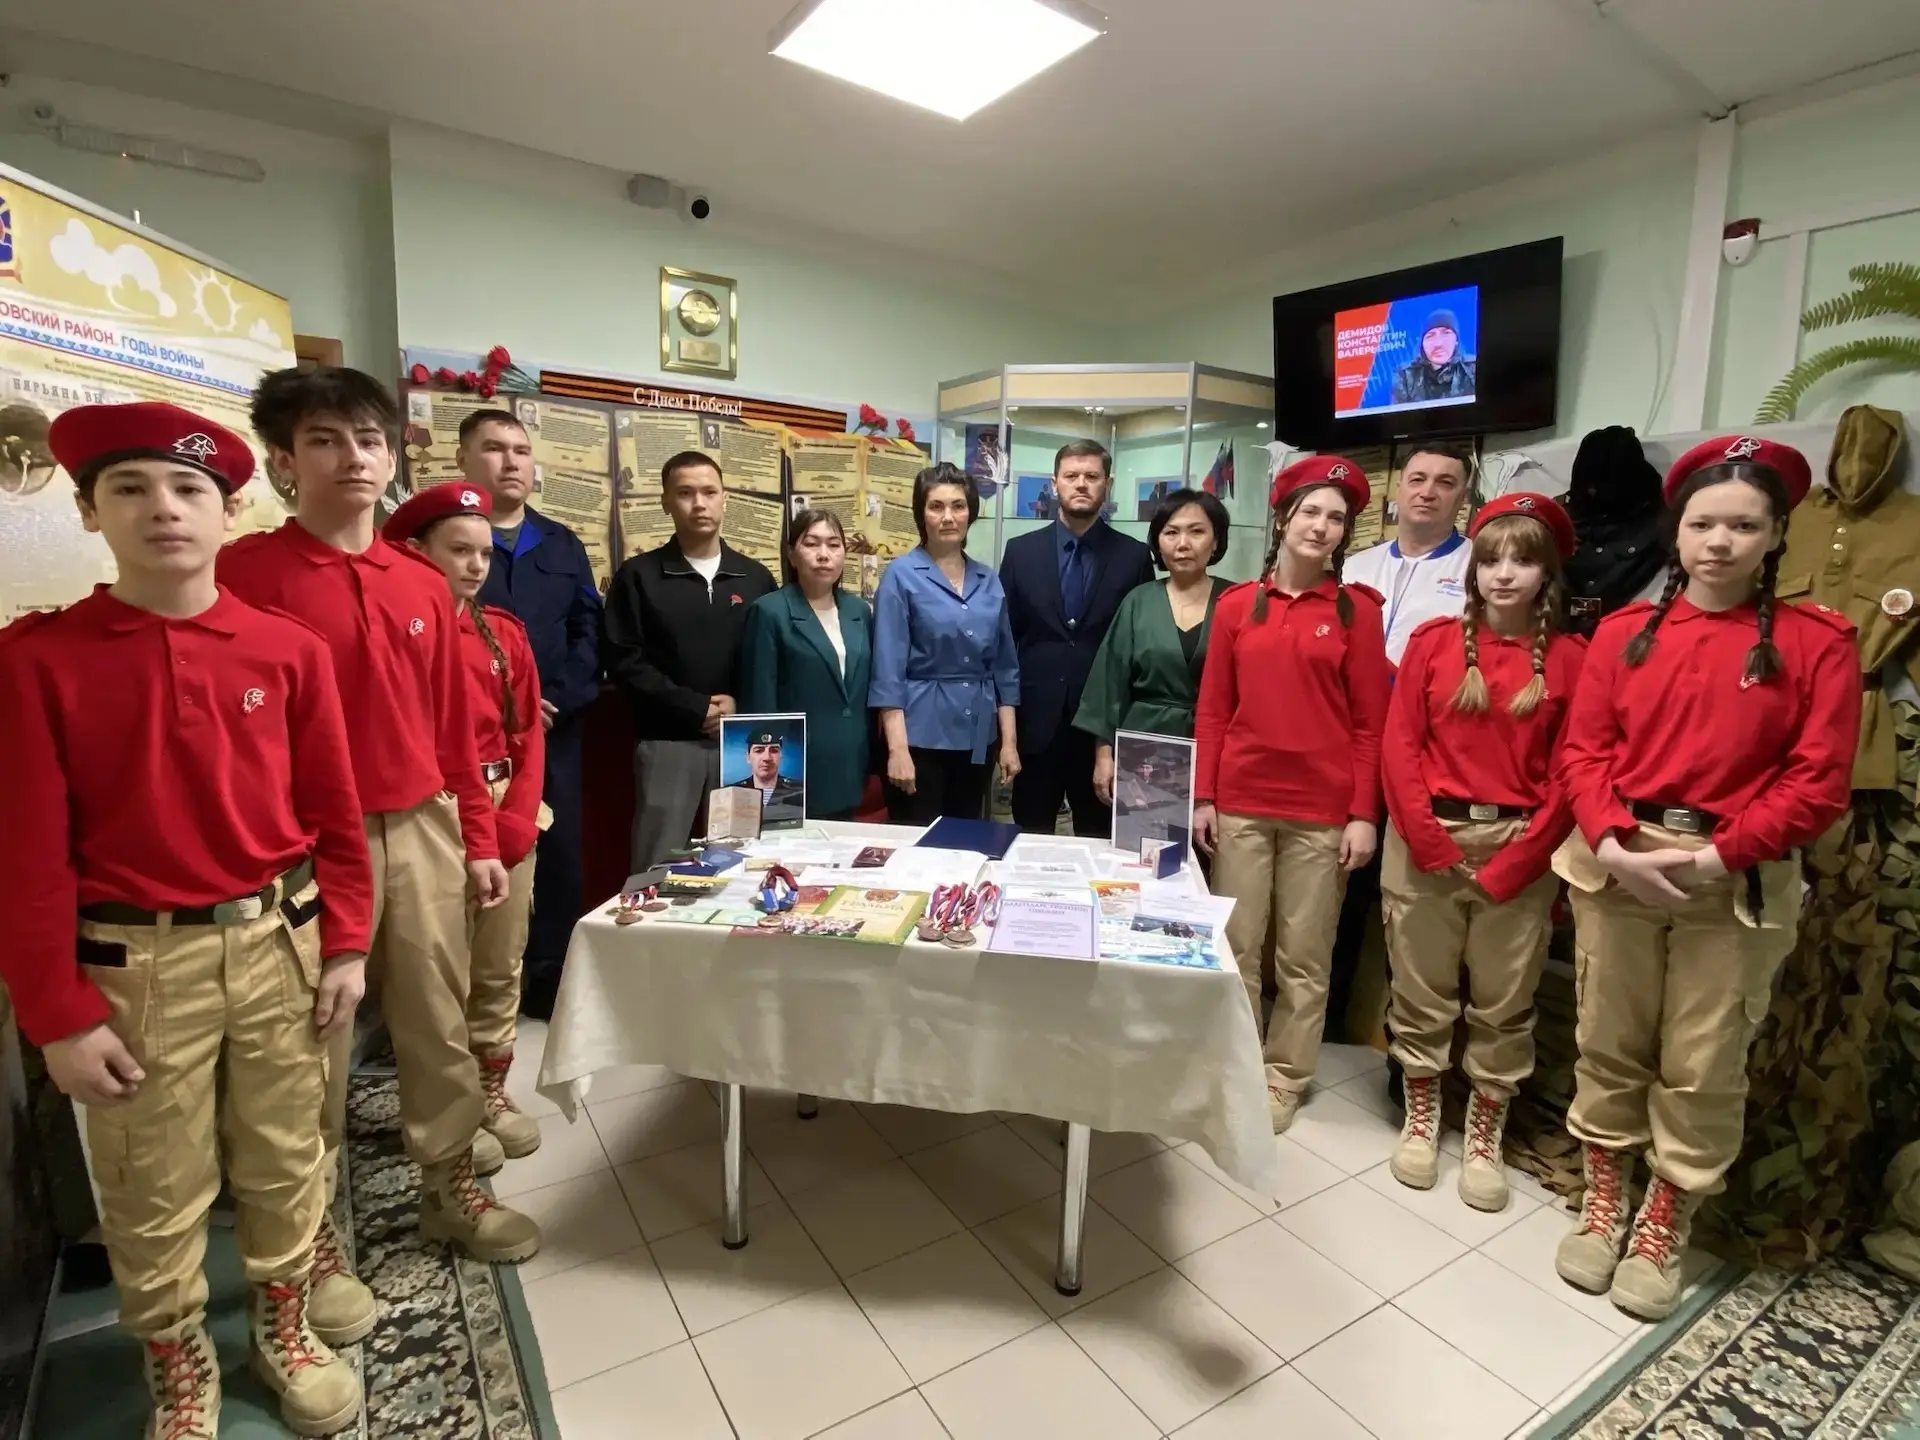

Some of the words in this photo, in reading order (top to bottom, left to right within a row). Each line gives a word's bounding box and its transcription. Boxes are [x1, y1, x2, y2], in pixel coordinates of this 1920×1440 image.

[1337, 323, 1389, 342] ДЕМИДОВ
[1337, 330, 1407, 350] КОНСТАНТИН
[120, 335, 157, 358] ГОДЫ
[160, 346, 205, 370] ВОЙНЫ
[1337, 339, 1406, 359] ВАЛЕРЬЕВИЧ
[632, 387, 645, 405] С
[647, 389, 684, 409] Днем
[688, 393, 743, 417] Победы!
